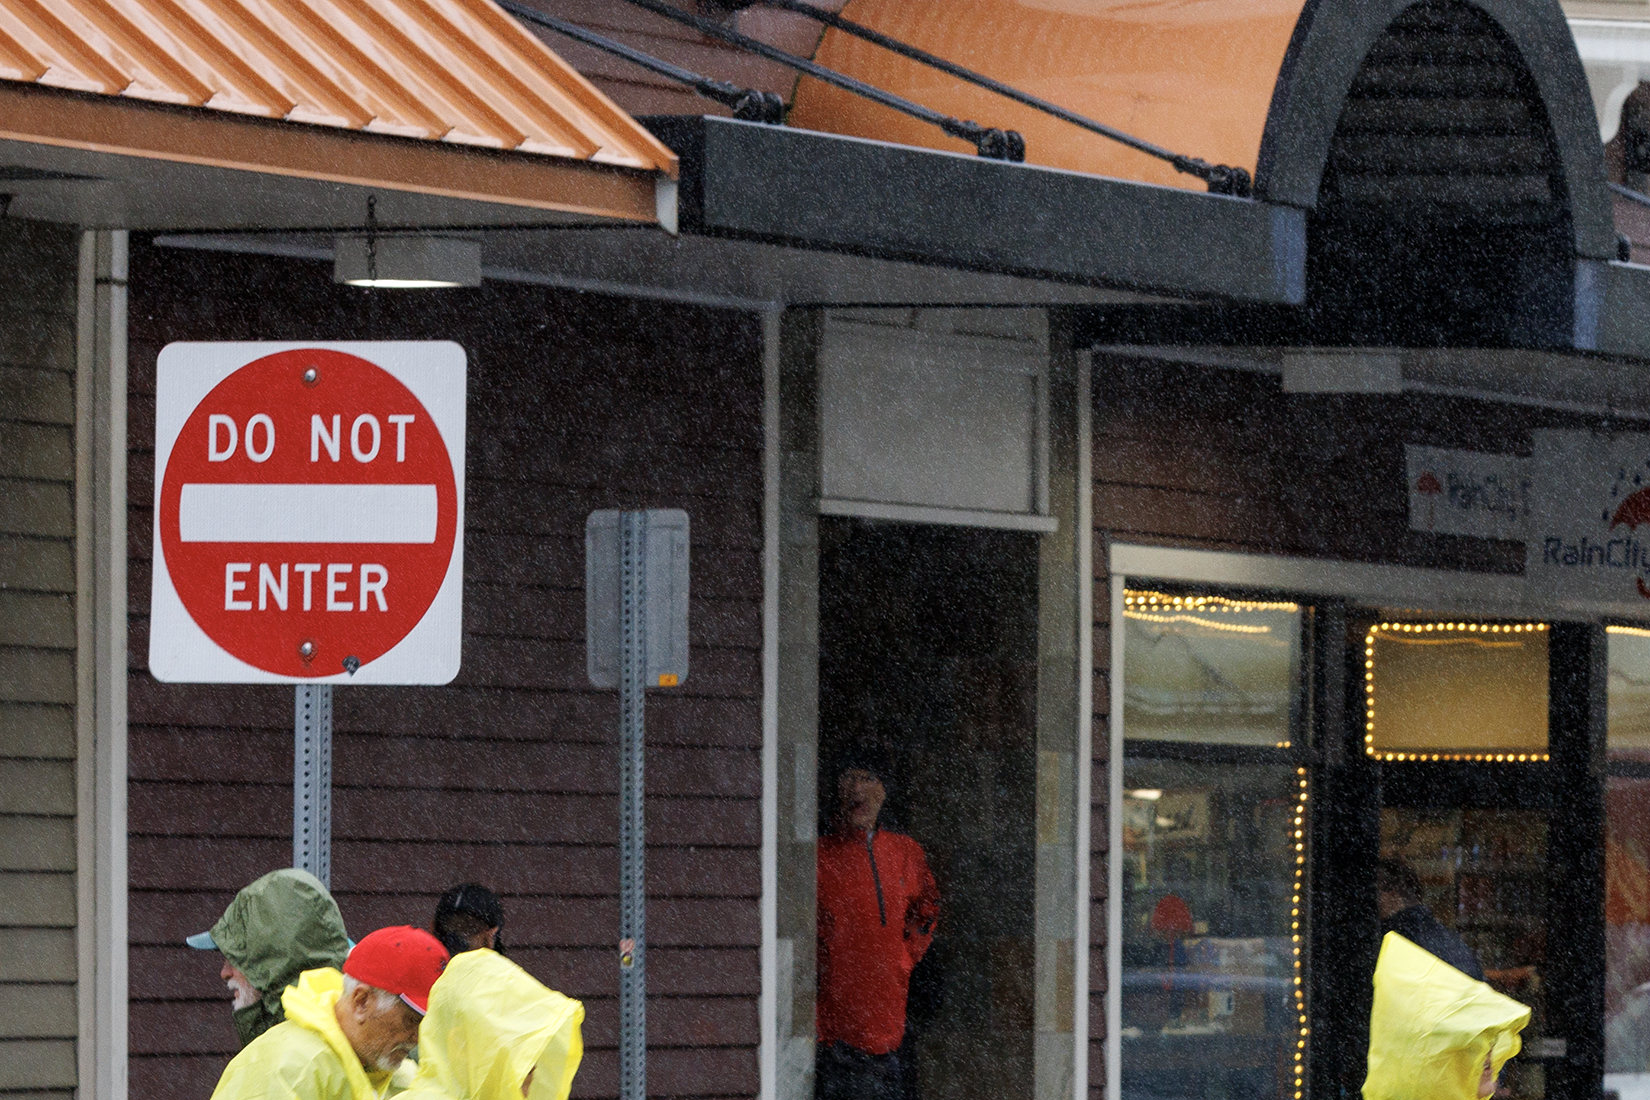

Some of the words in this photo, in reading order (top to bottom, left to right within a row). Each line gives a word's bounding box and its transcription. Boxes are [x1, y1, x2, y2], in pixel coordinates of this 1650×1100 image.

[207, 413, 276, 463] DO
[310, 413, 416, 464] NOT
[224, 562, 390, 613] ENTER
